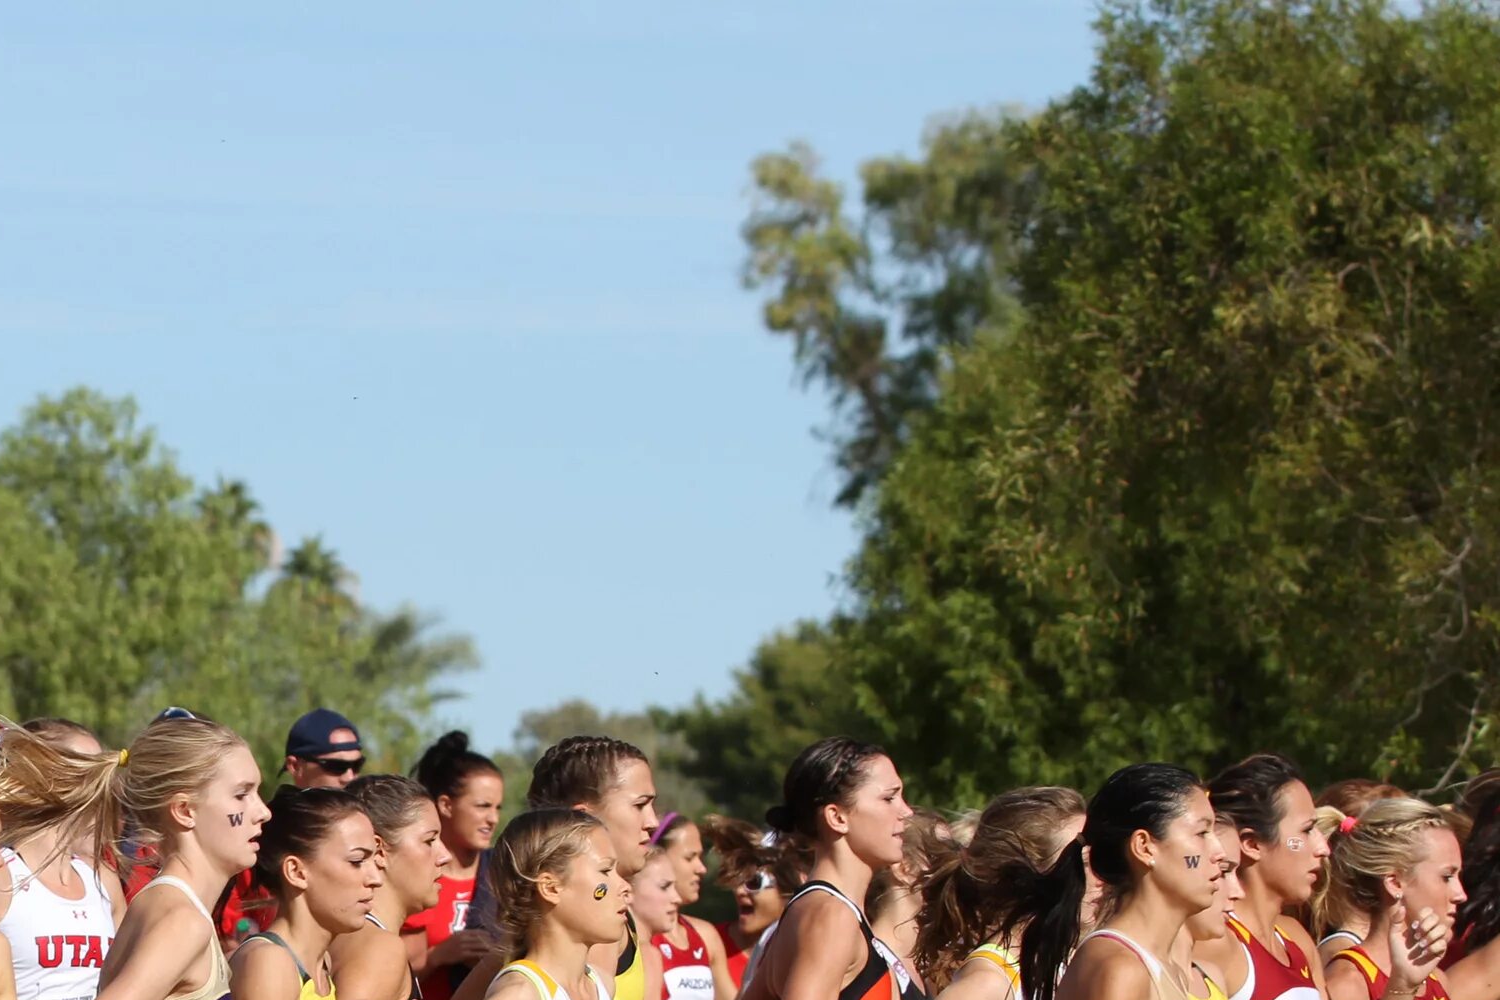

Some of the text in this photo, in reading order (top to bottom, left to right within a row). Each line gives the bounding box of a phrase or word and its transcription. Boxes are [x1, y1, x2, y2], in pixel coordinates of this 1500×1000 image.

[227, 811, 244, 827] W
[1183, 855, 1200, 868] W
[35, 935, 114, 968] UTA
